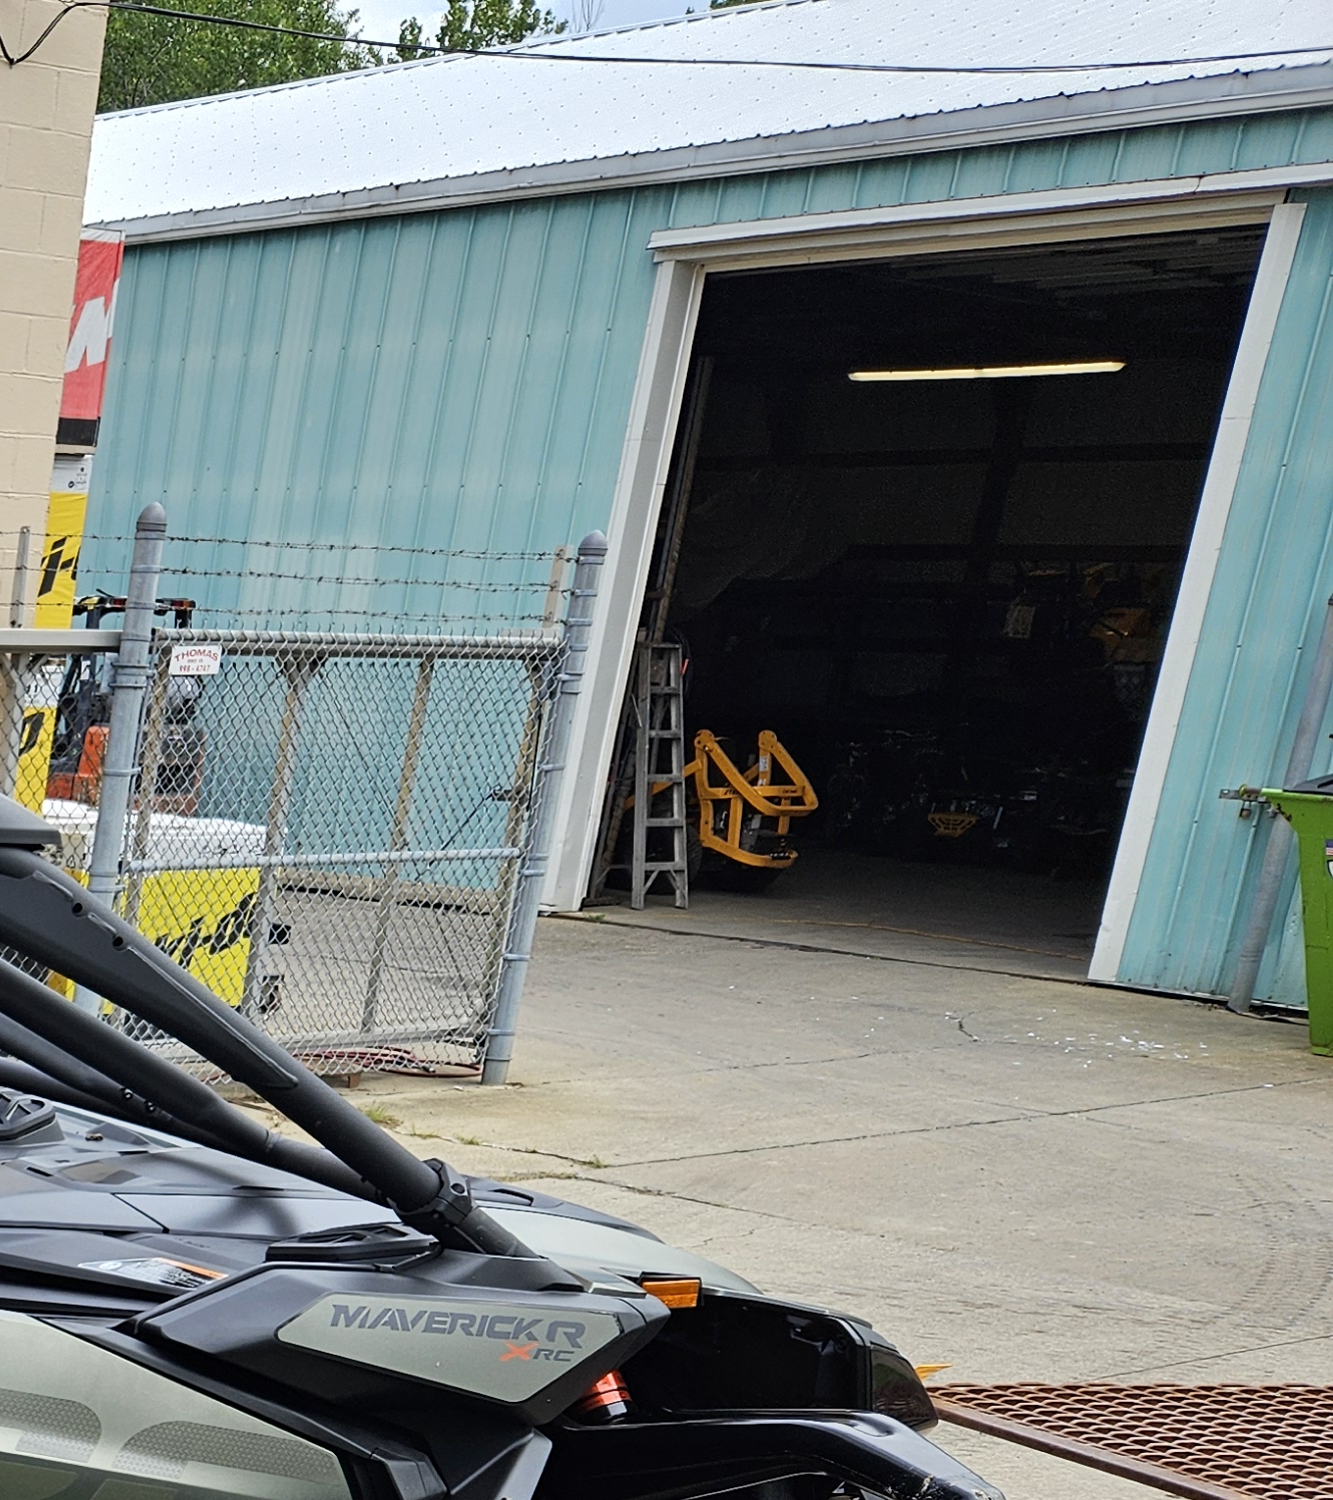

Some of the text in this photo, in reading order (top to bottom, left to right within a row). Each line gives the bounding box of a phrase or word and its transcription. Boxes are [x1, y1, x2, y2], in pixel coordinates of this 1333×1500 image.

[175, 649, 218, 661] THOMAS
[330, 1304, 587, 1349] MAVERICK R
